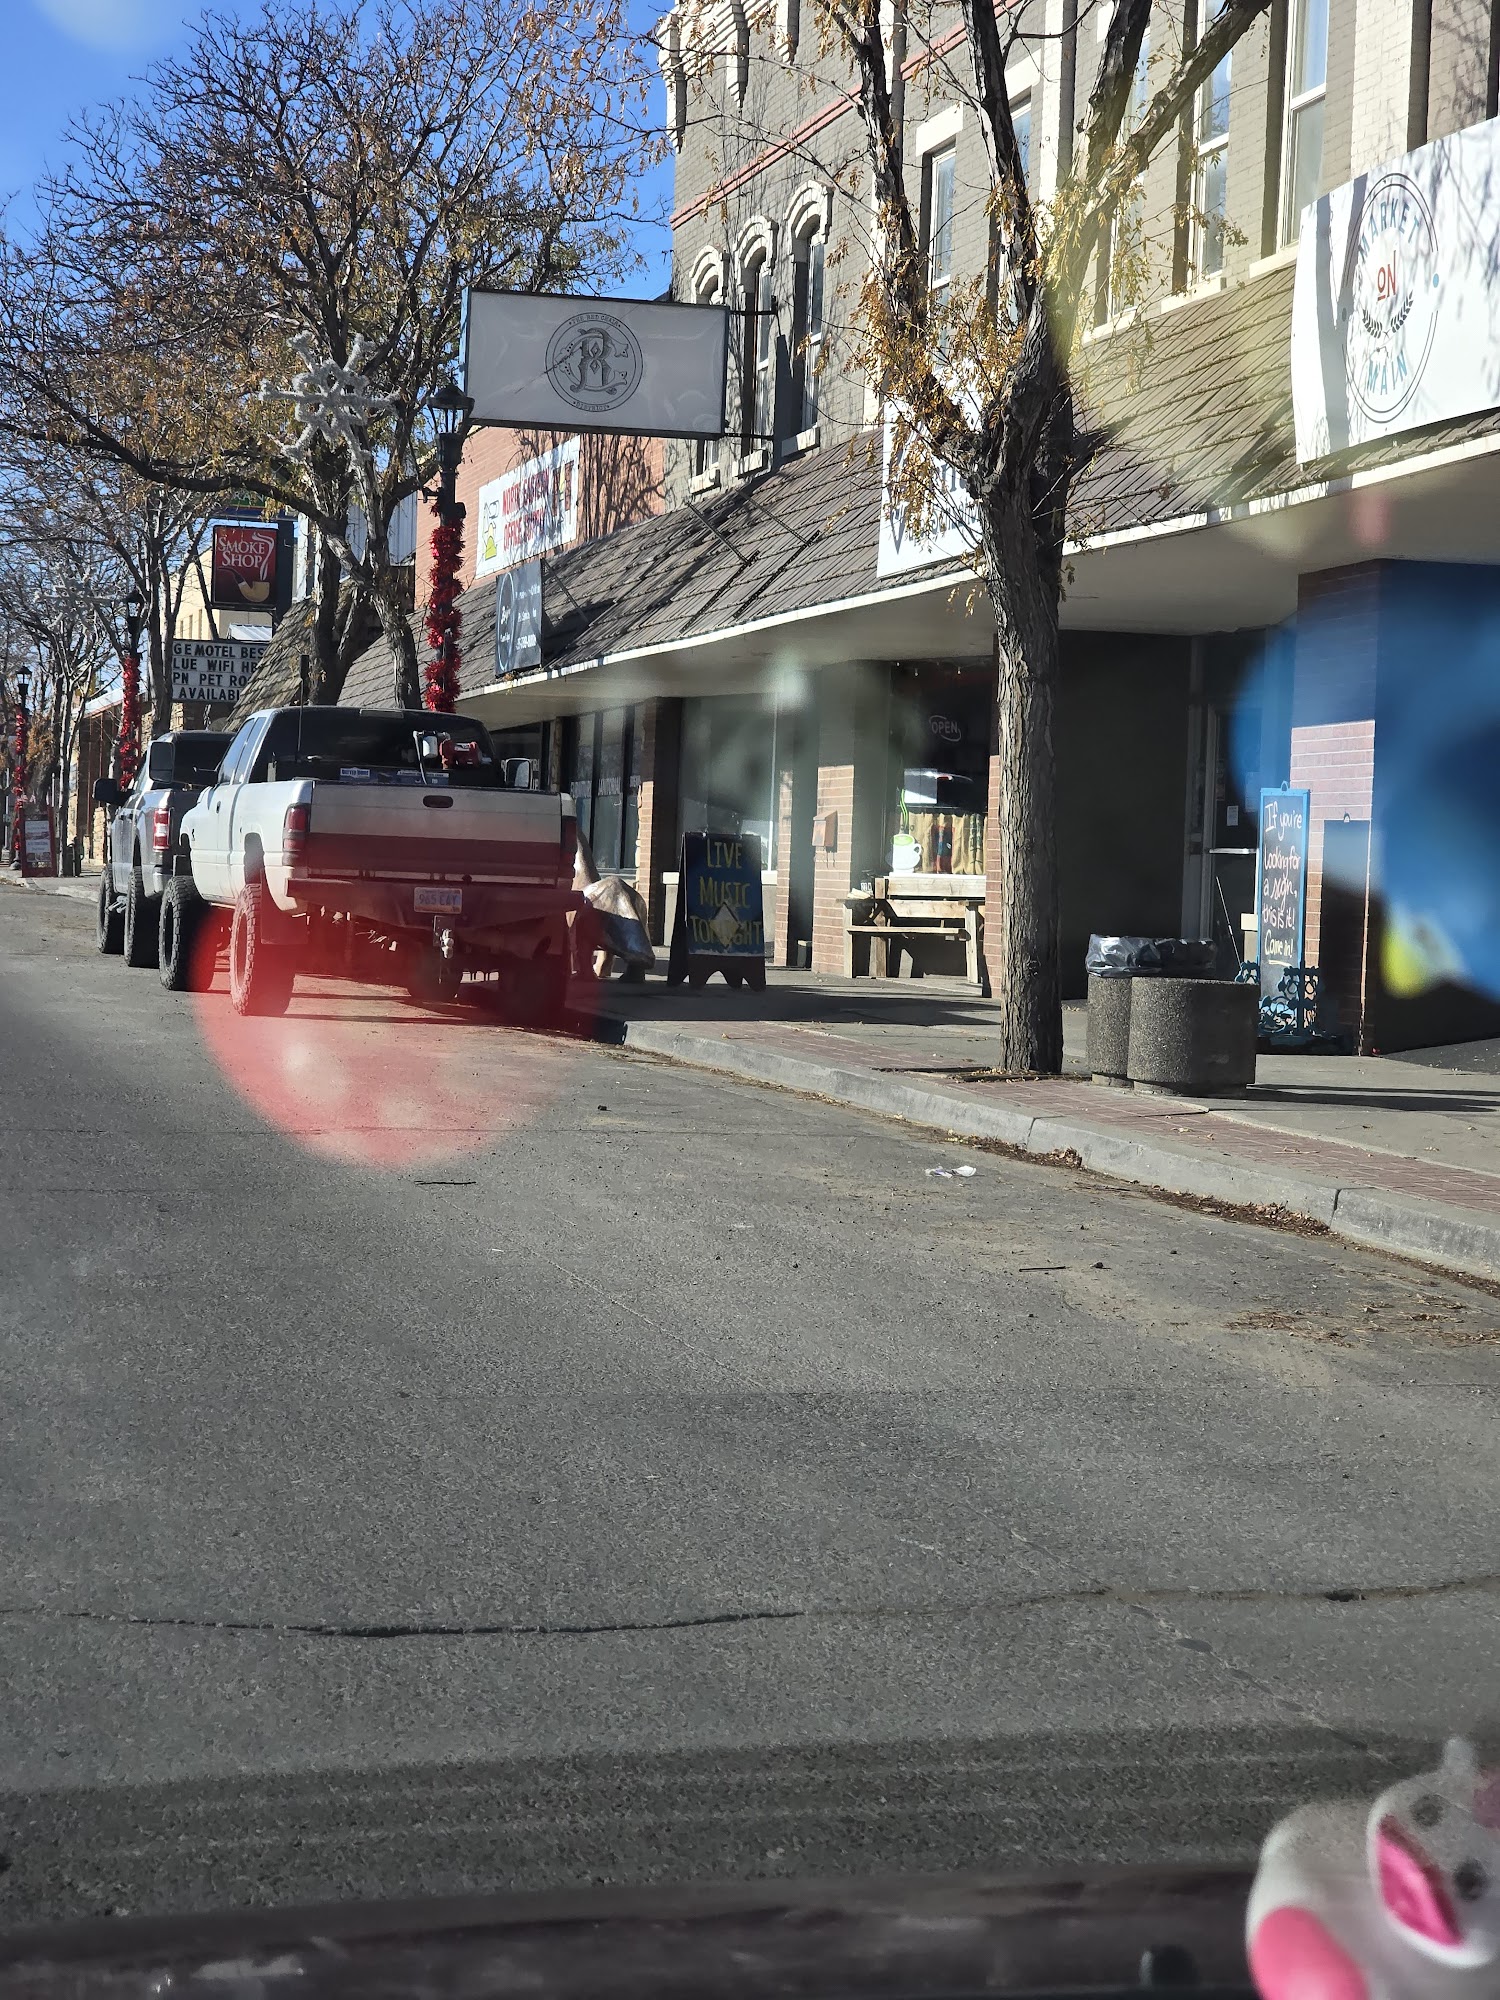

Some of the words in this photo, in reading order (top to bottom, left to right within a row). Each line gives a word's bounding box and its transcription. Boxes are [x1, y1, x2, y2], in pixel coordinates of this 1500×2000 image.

[1357, 196, 1420, 263] MARKET
[1377, 250, 1397, 301] ON
[1366, 350, 1408, 396] MAIN
[217, 536, 265, 555] SMOKE
[221, 550, 263, 568] SHOP
[194, 644, 236, 658] MOTEL
[207, 660, 234, 672] WIFI
[200, 673, 223, 686] PET
[229, 675, 251, 687] RO
[931, 721, 958, 734] OPEN
[1265, 800, 1279, 833] If
[1279, 808, 1303, 842] you're
[706, 838, 743, 869] LIVE
[1289, 844, 1301, 871] for
[700, 875, 751, 910] MUSIC
[1263, 877, 1270, 897] a
[1264, 929, 1284, 956] Come
[1283, 938, 1294, 959] in!
